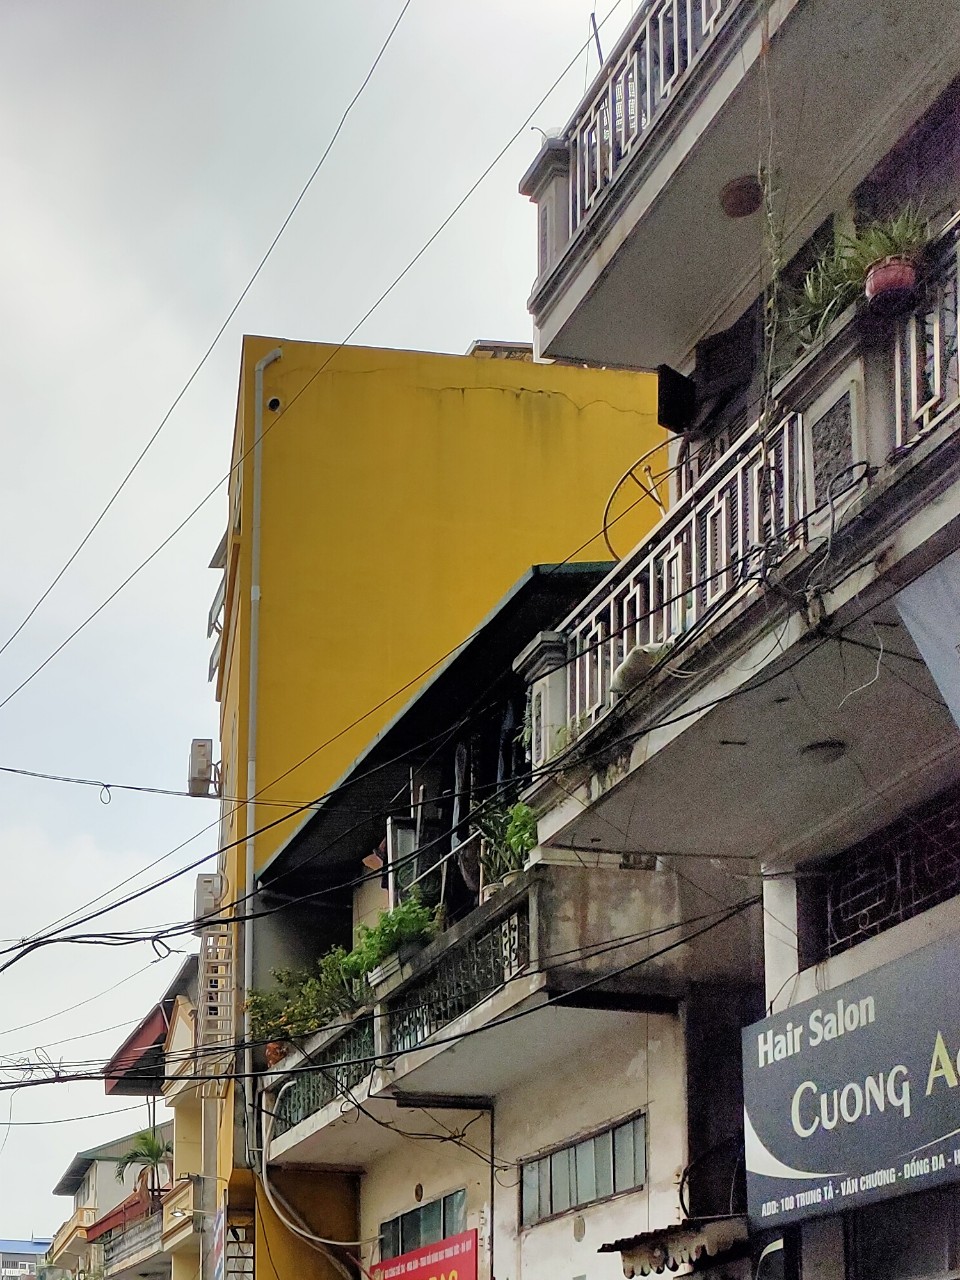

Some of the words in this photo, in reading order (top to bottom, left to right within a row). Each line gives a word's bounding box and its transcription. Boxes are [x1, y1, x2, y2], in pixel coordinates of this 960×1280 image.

[757, 1022, 804, 1068] Hair
[809, 995, 876, 1047] Salon
[925, 1029, 960, 1097] A
[761, 1202, 779, 1218] ADD:
[796, 1188, 822, 1208] TRUNG
